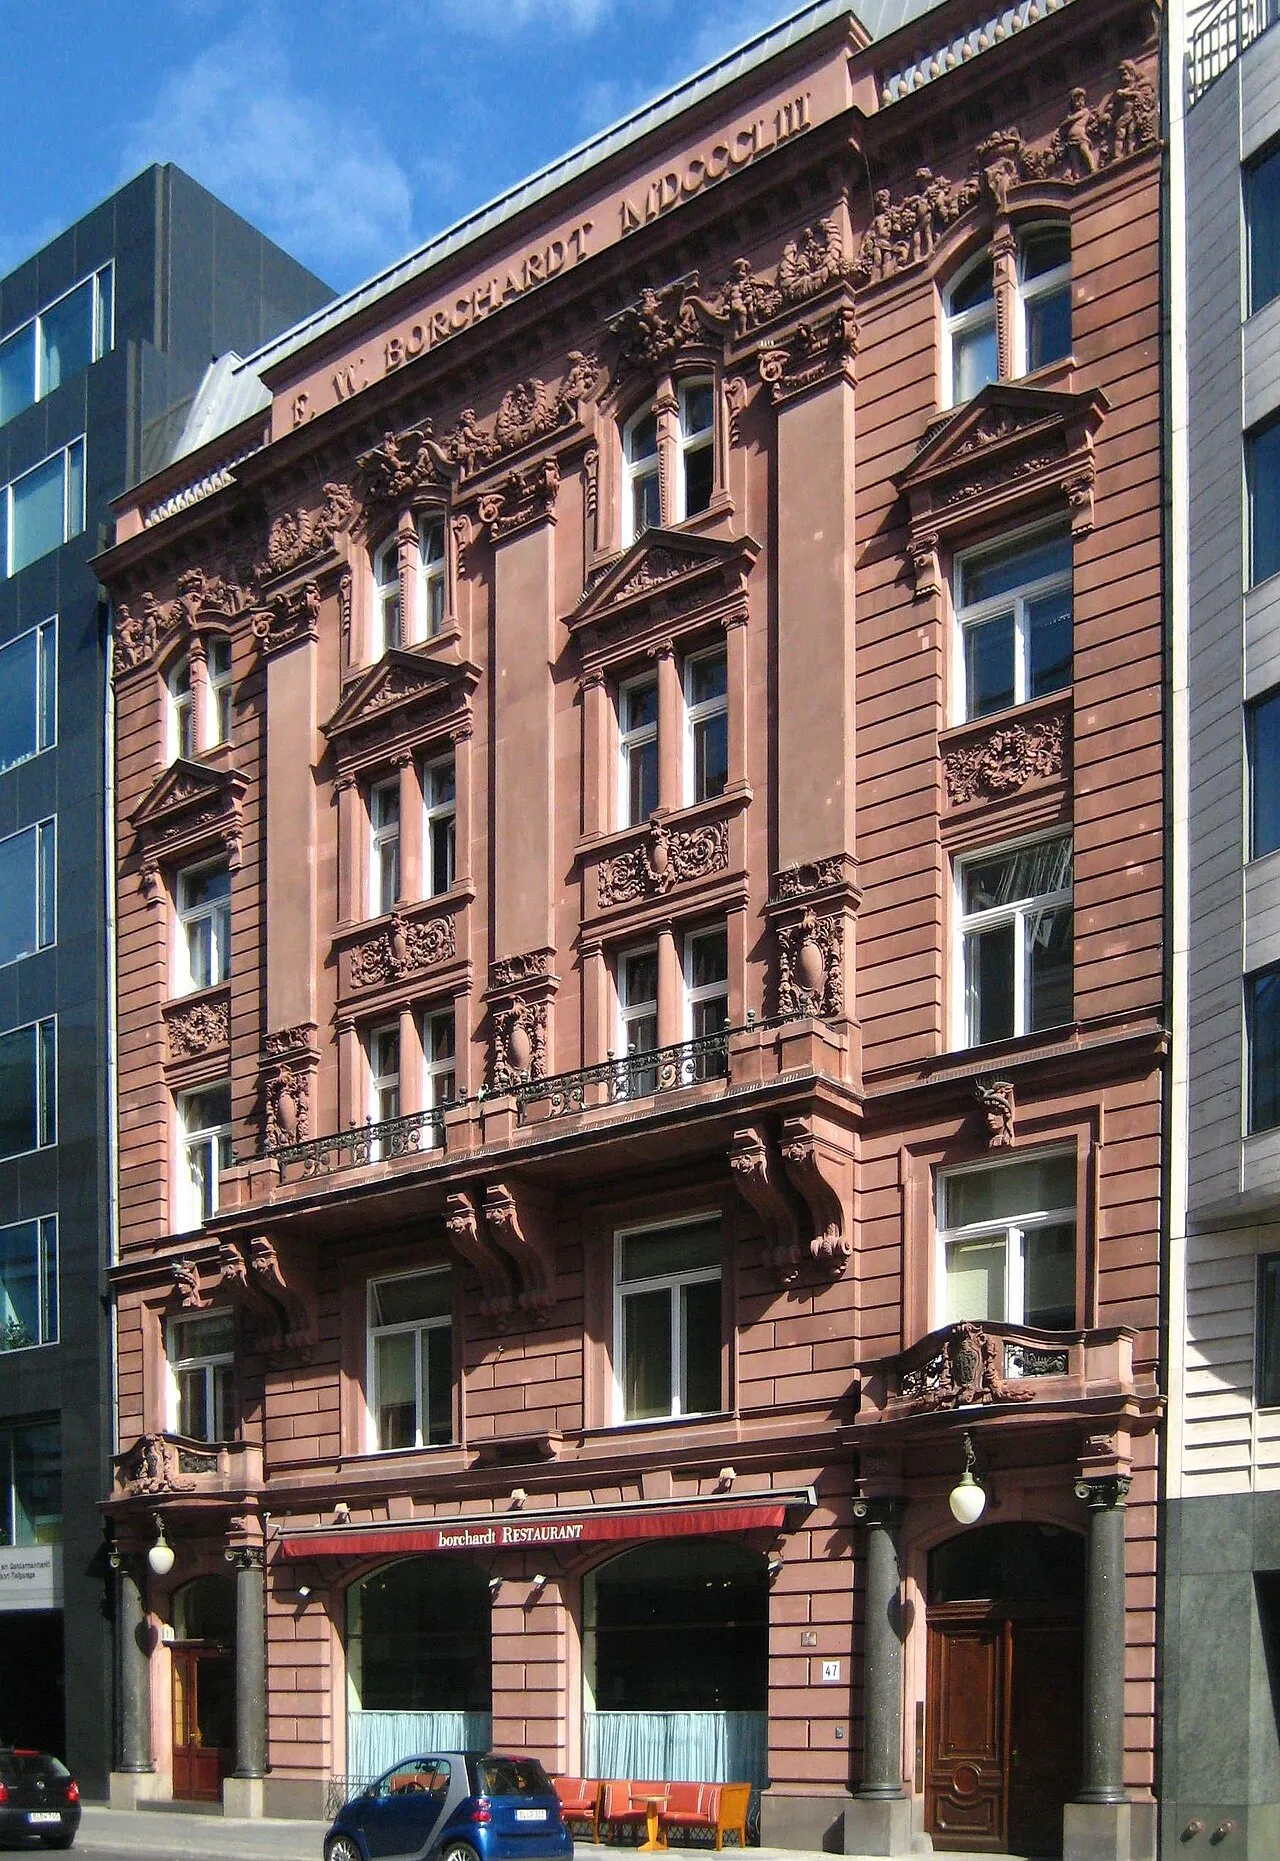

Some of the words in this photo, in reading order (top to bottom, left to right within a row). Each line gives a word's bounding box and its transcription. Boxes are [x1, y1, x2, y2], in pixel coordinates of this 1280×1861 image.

[384, 220, 595, 374] BORCHARDT
[620, 91, 812, 237] MDCCCLIII
[438, 1528, 496, 1547] borchardt
[502, 1524, 583, 1543] RESTAURANT
[825, 1664, 837, 1676] 47
